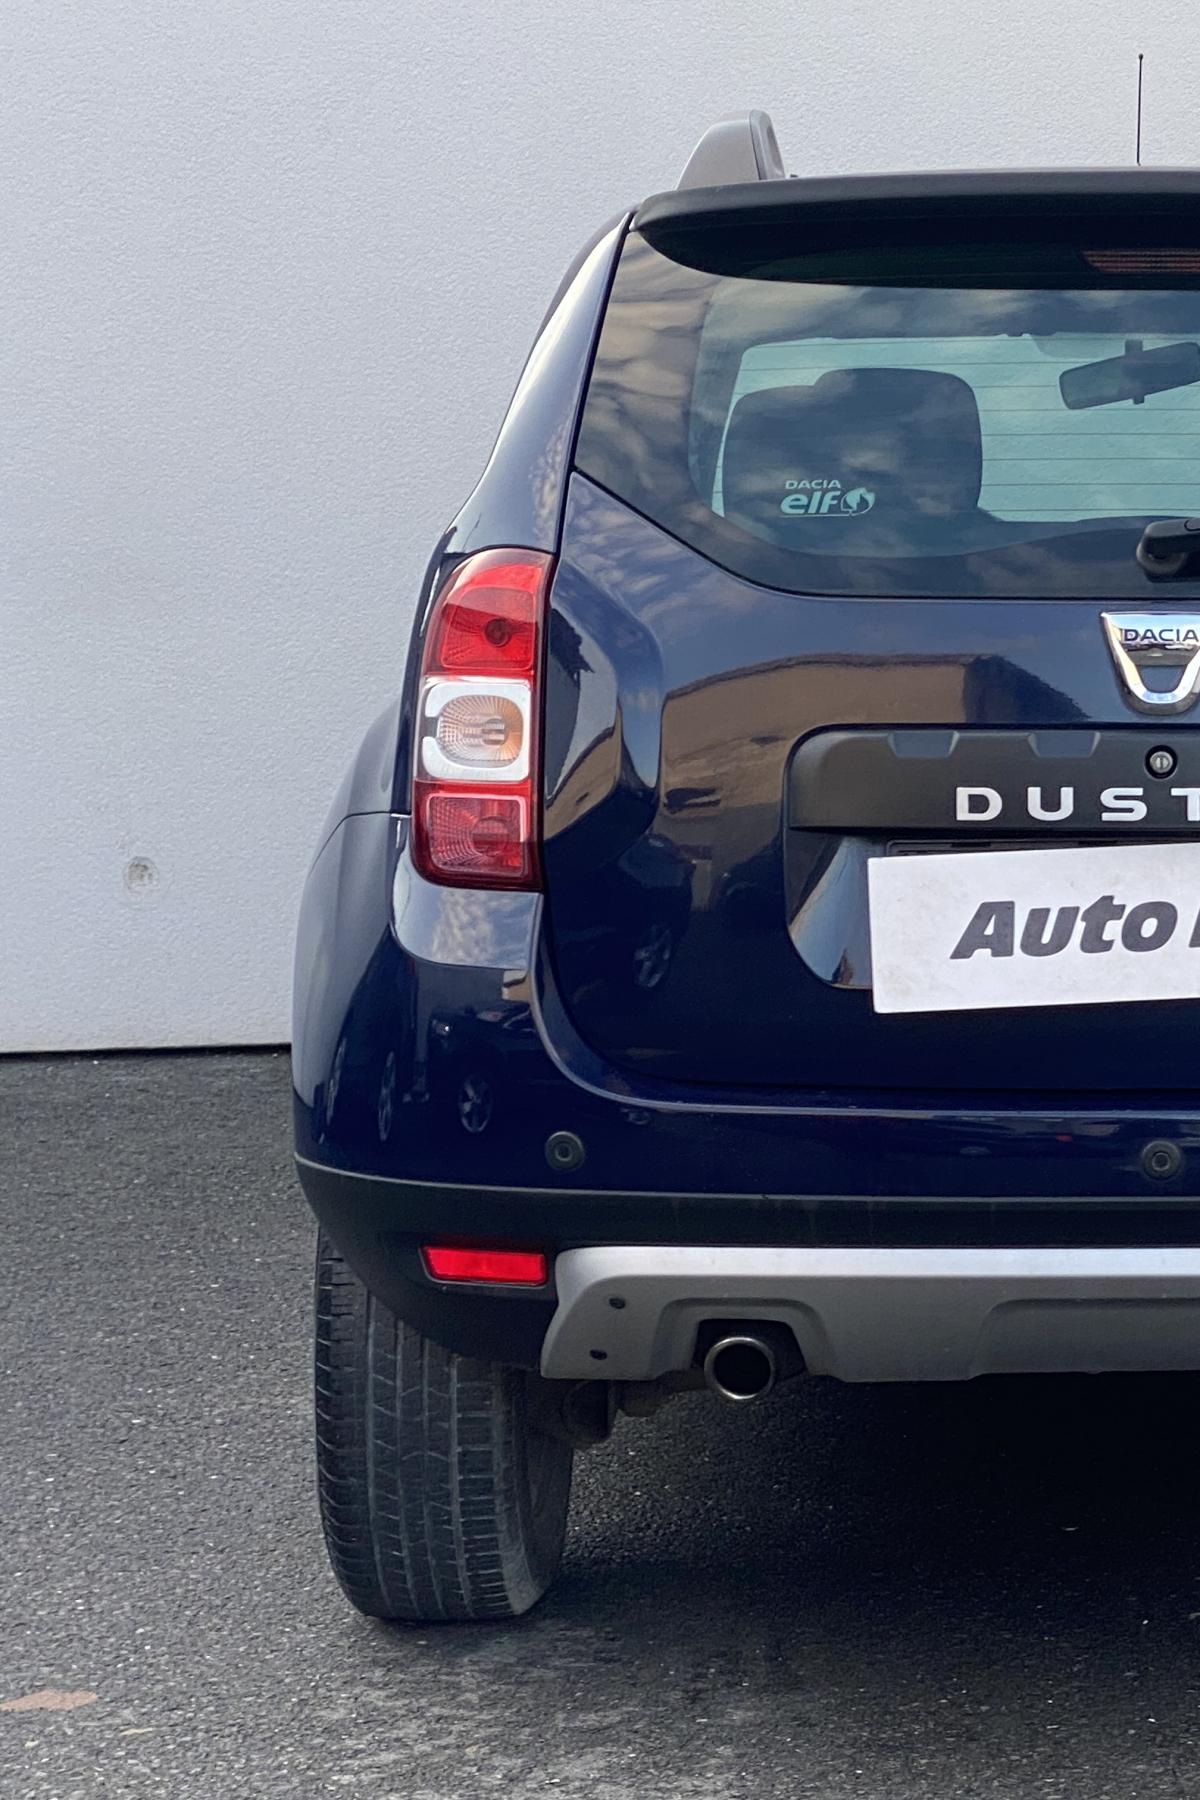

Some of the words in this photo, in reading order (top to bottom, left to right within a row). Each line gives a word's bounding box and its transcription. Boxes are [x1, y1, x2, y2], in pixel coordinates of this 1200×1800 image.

[785, 479, 842, 490] DACIA
[780, 491, 841, 514] elf
[1123, 628, 1199, 642] DACIA
[949, 896, 1178, 959] Auto
